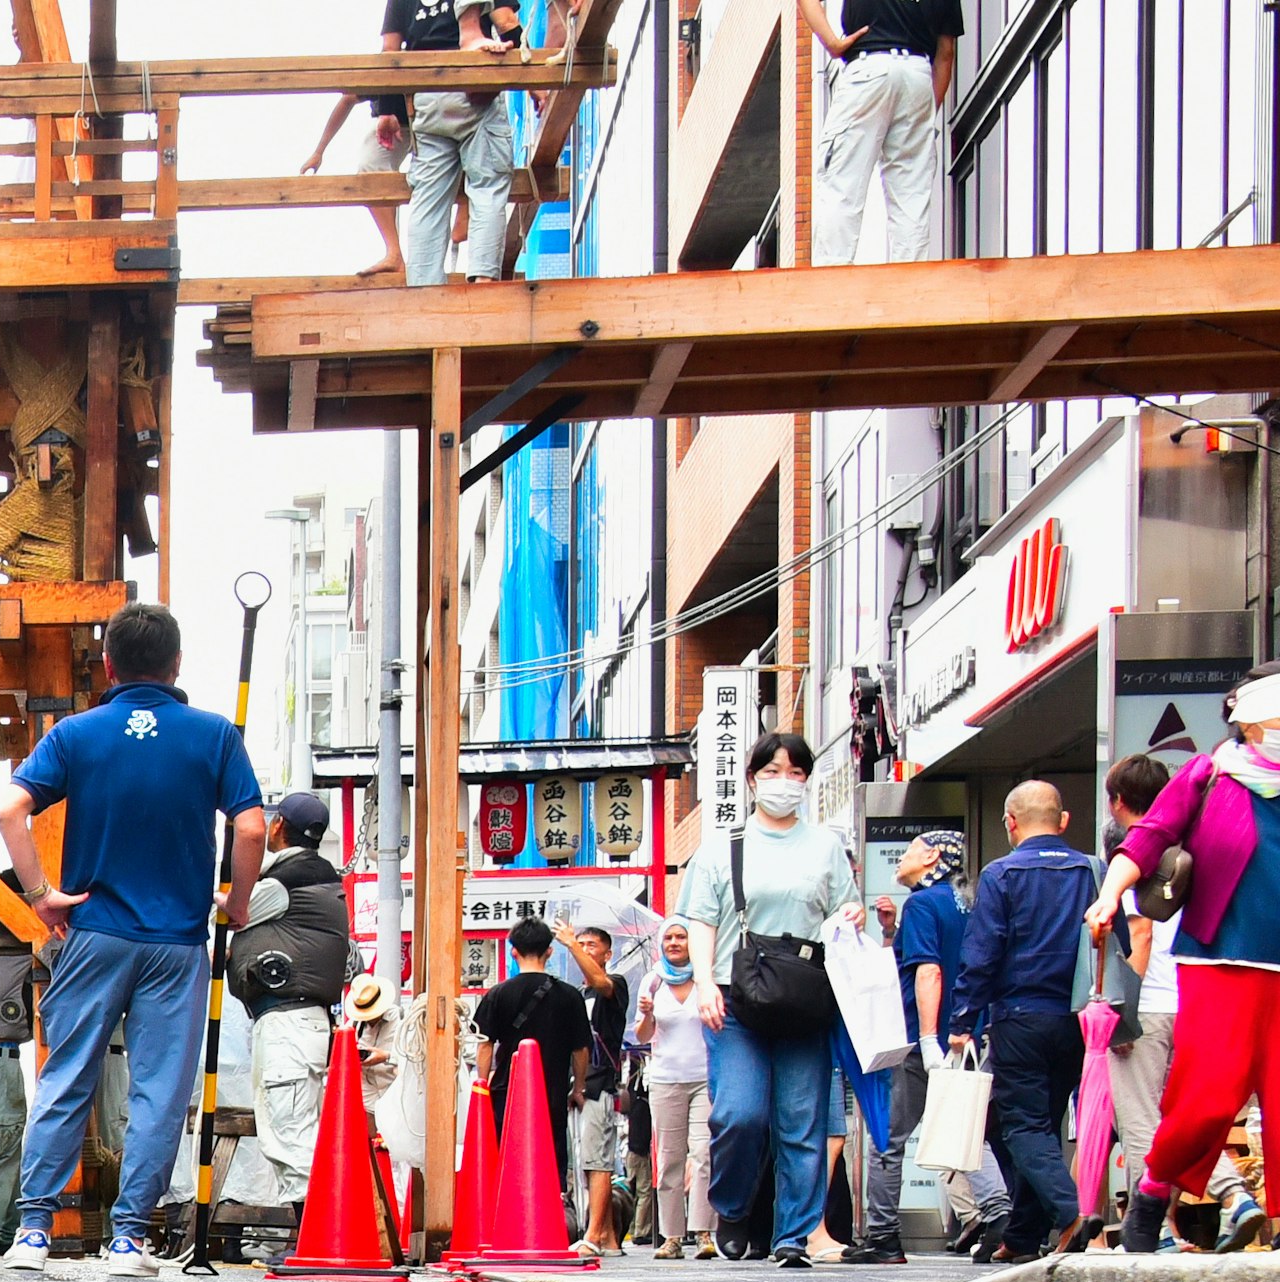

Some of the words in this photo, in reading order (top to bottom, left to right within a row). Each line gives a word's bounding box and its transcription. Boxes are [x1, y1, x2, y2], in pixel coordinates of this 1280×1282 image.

[715, 686, 738, 829] 岡本会計事務
[542, 780, 568, 850] 函谷鉾
[607, 778, 633, 846] 函谷鉾
